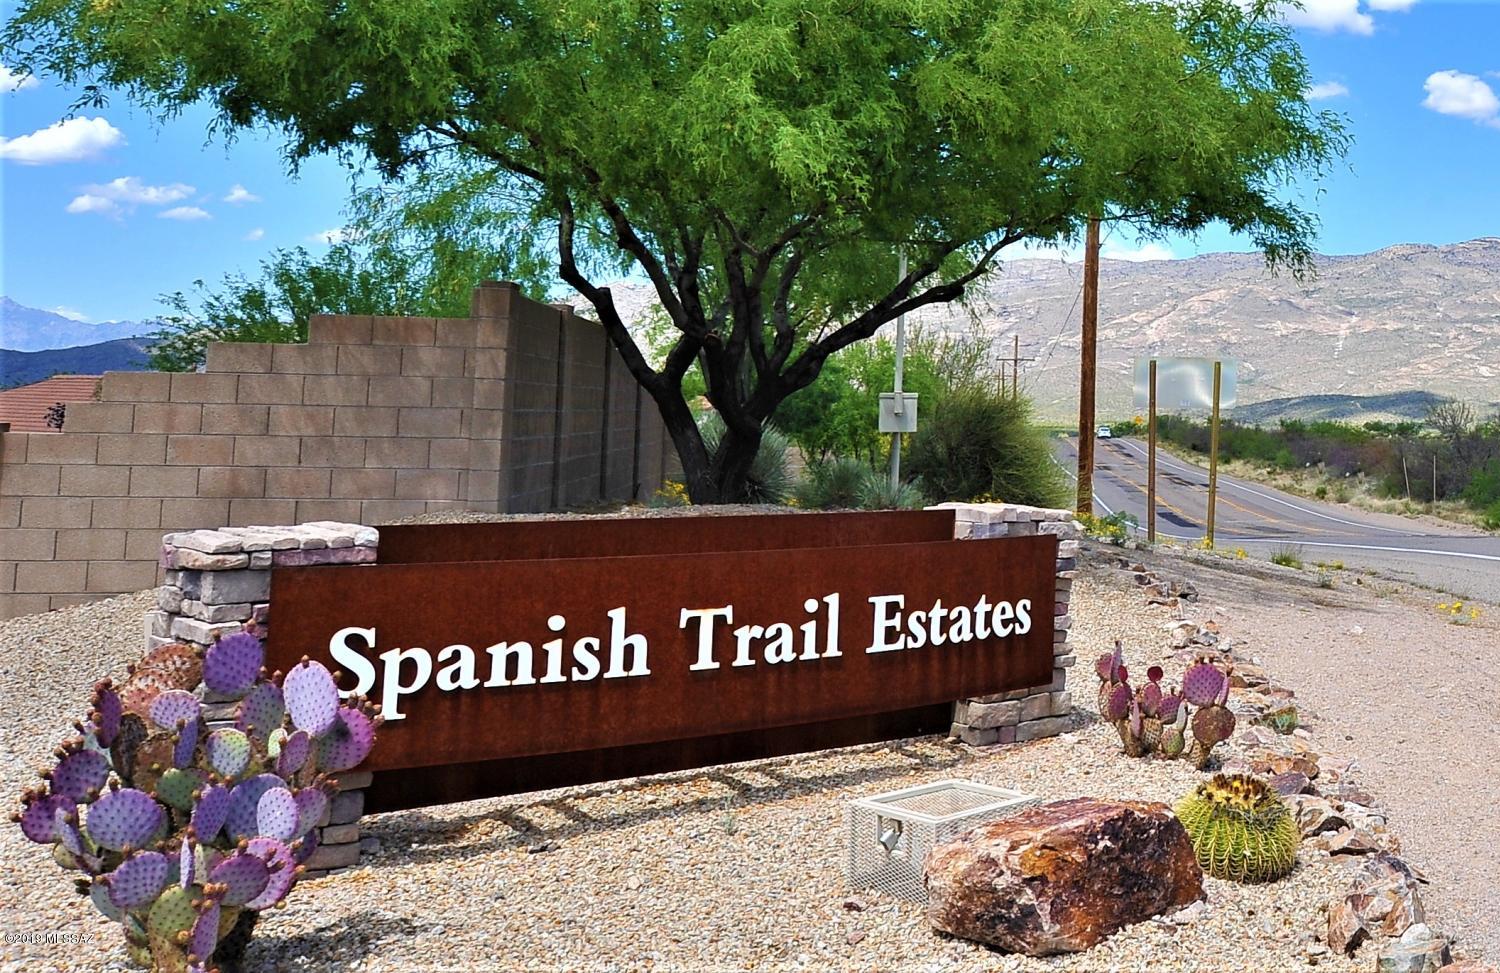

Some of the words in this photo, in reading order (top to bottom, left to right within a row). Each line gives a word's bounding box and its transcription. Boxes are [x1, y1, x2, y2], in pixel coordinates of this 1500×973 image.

[329, 607, 651, 721] Spanish
[679, 593, 843, 671] Trail
[865, 594, 1032, 654] Estates
